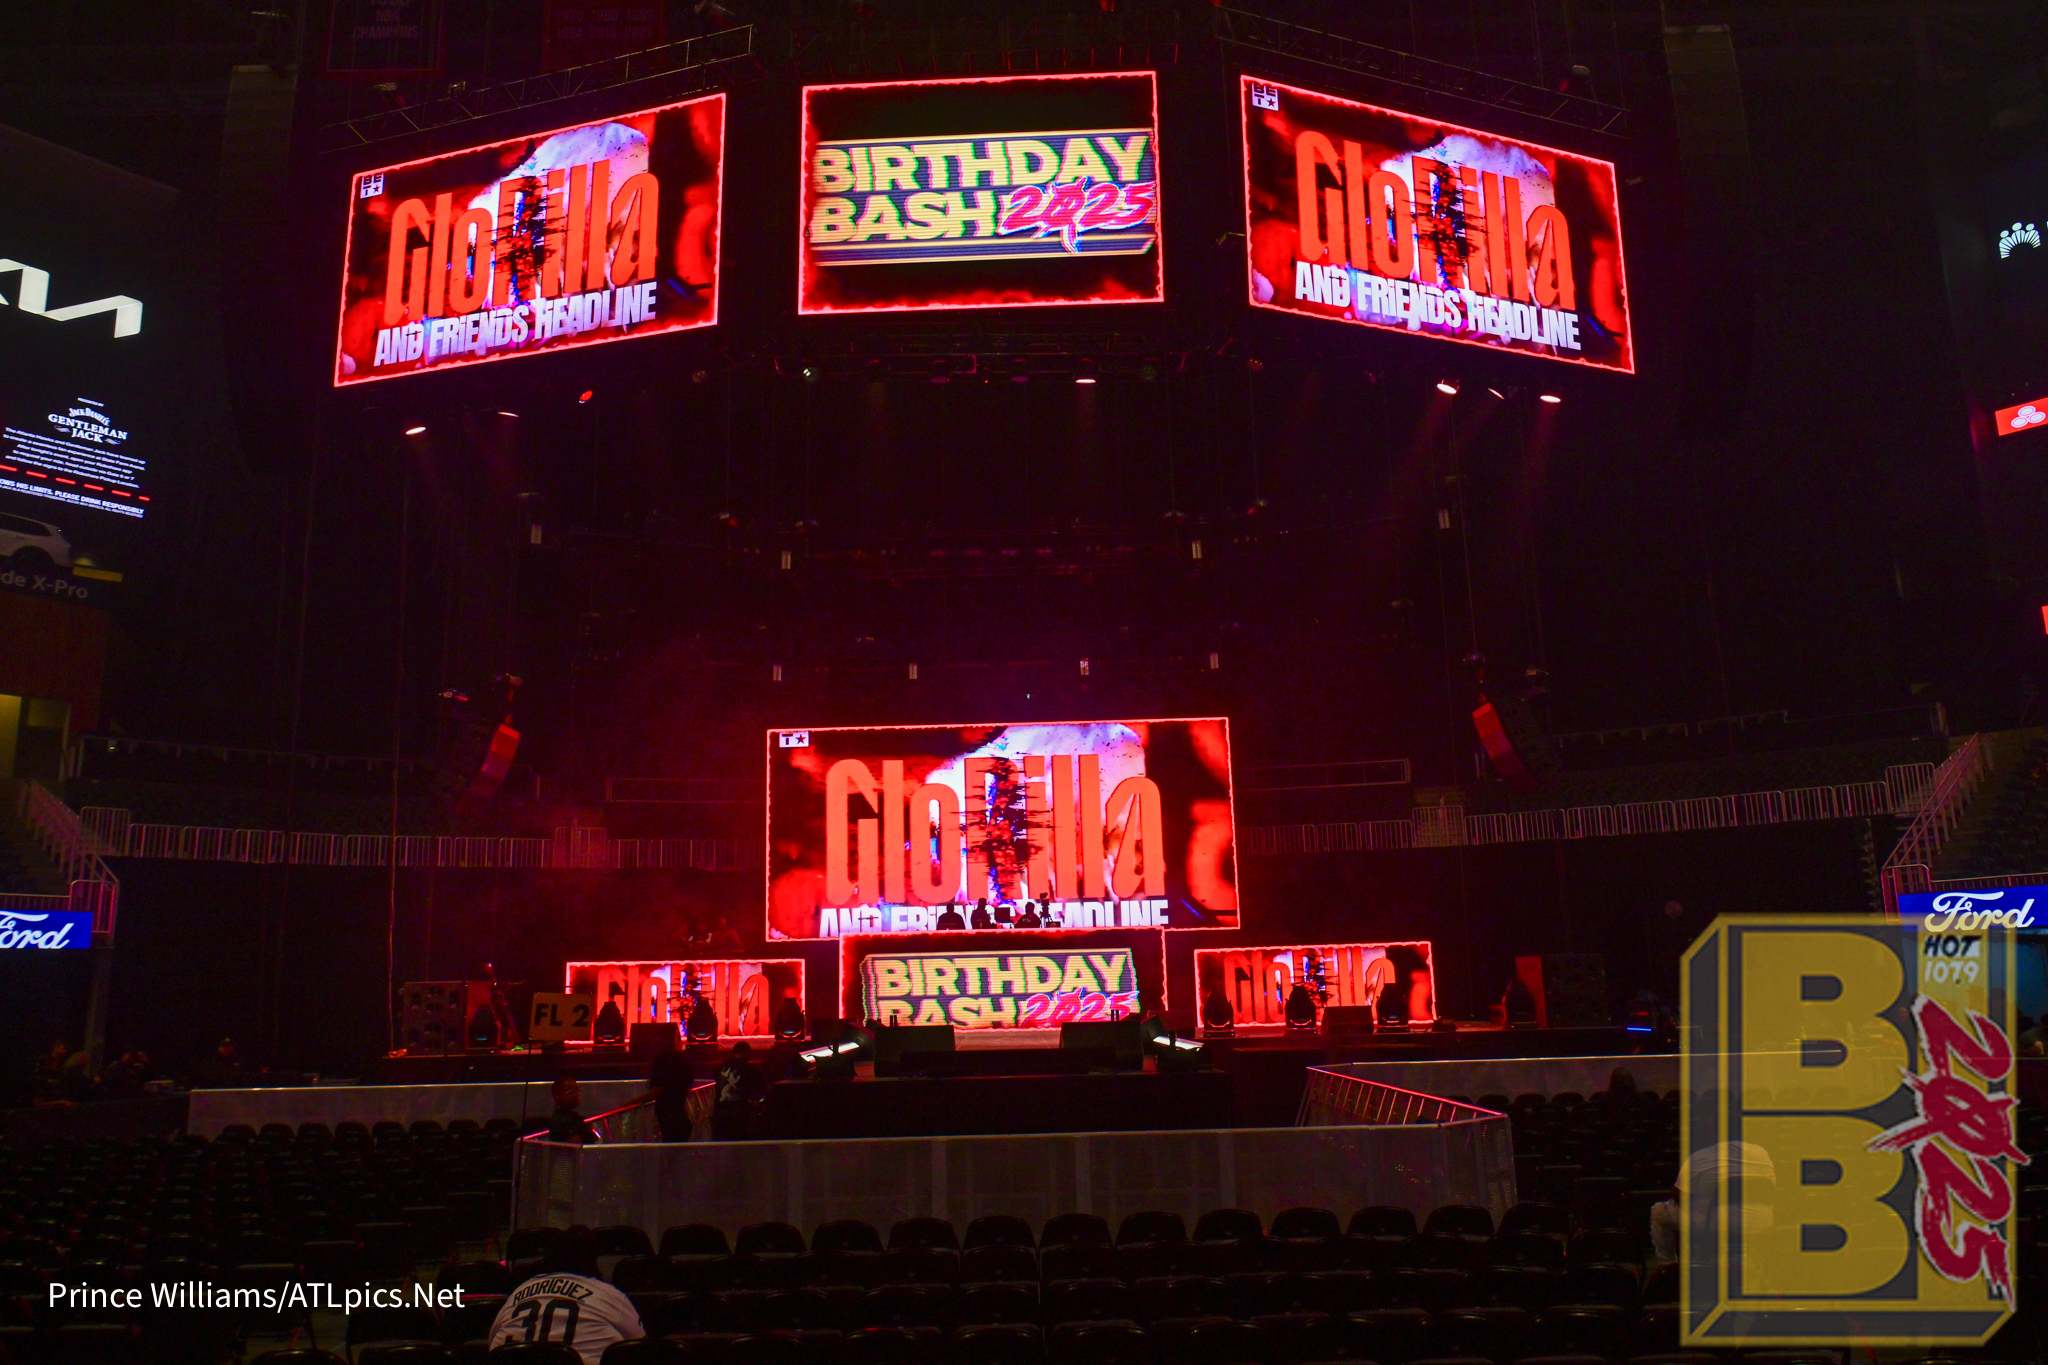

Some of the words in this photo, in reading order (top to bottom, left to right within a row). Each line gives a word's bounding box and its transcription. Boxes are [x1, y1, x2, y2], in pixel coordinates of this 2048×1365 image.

[812, 136, 1151, 193] BIRTHDAY
[810, 190, 997, 243] BASH
[997, 176, 1157, 253] 2025
[374, 323, 424, 366] AND
[533, 281, 657, 339] HEADLINE
[1295, 261, 1350, 307] AND
[1468, 293, 1581, 350] HEADLINE
[48, 414, 128, 440] GENTLEMAN
[71, 427, 103, 443] JACK
[54, 490, 80, 501] PLEASE
[32, 574, 88, 599] X-Pro
[1924, 891, 2035, 932] Ford
[873, 955, 1129, 996] BIRTHDAY
[534, 1003, 562, 1028] FL
[571, 1004, 590, 1028] 2
[512, 1279, 594, 1306] RODRIGUEZ
[505, 1299, 581, 1346] 30
